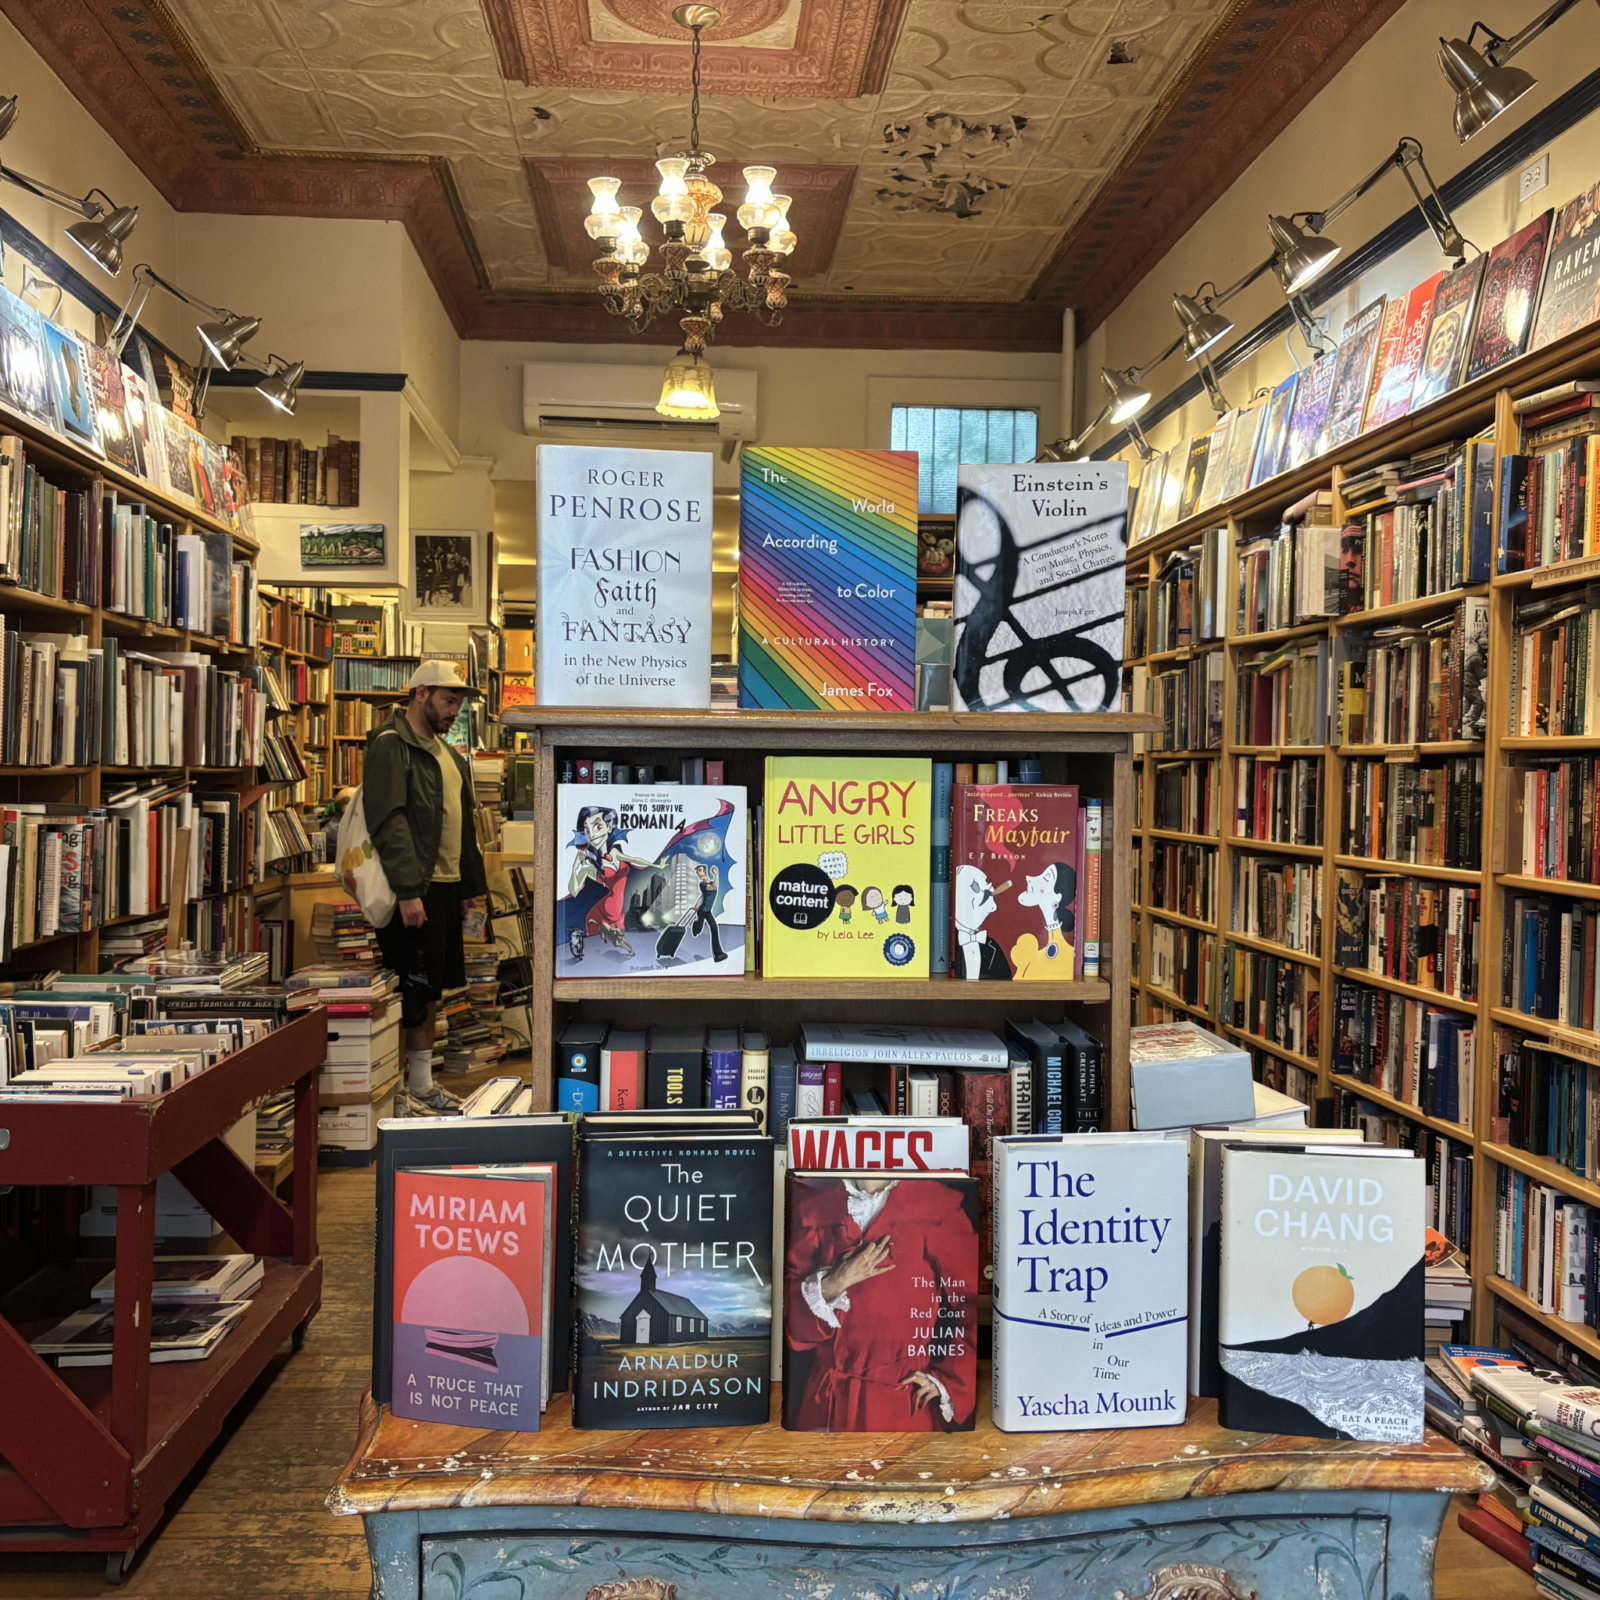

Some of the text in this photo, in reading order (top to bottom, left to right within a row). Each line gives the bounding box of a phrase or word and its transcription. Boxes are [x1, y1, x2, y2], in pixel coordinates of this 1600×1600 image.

[1554, 264, 1594, 294] TRAVELLING
[587, 468, 665, 488] ROGER
[761, 467, 788, 484] The
[1012, 472, 1108, 492] Einstein's
[549, 494, 702, 523] PENROSE
[851, 498, 895, 514] World
[1032, 498, 1087, 517] Violin
[762, 532, 838, 555] According
[1022, 531, 1109, 566] A Conductor's Notes
[571, 547, 681, 573] FASHION
[1036, 543, 1112, 574] on Music, Physics,
[1038, 553, 1116, 586] and Social Change
[594, 576, 657, 610] Faith
[837, 583, 896, 599] to Color
[616, 606, 634, 616] and
[1054, 608, 1078, 617] Joseph
[560, 612, 692, 644] FANTASY
[761, 637, 895, 647] A CULTURAL HISTORY
[564, 653, 688, 671] in the New Physics
[575, 672, 676, 687] of the Universe
[819, 682, 893, 697] James Fox
[620, 803, 683, 813] HOW TO SURVIVE
[778, 780, 916, 818] ANGRY
[620, 813, 686, 833] ROMANIA
[973, 804, 1039, 822] FREAKS
[778, 823, 916, 846] LITTLE GIRLS
[985, 825, 1071, 848] Mayfair
[991, 852, 1026, 860] BENSON
[778, 880, 829, 895] mature
[776, 893, 829, 909] content
[817, 930, 830, 941] by
[858, 930, 874, 940] Lee
[231, 1000, 246, 1008] THE
[249, 1000, 273, 1008] AGES
[811, 1047, 972, 1062] IRRELIGION JOHN ALLEN PAULOS
[666, 1067, 684, 1104] TOOLS
[800, 1071, 823, 1080] palgrave
[1047, 1056, 1062, 1104] MICHAEL
[1079, 1051, 1087, 1102] GREENBLATT
[896, 1080, 903, 1094] MY
[985, 1087, 994, 1104] Fall
[778, 1091, 787, 1118] In My
[986, 1105, 994, 1117] On
[1077, 1110, 1099, 1118] THE
[985, 1118, 994, 1134] Your
[660, 1163, 703, 1184] The
[1016, 1160, 1096, 1199] The
[1267, 1173, 1383, 1207] DAVID
[410, 1193, 527, 1226] MIRIAM
[624, 1193, 737, 1233] QUIET
[1017, 1206, 1173, 1254] Identity
[1254, 1208, 1394, 1243] CHANG
[415, 1224, 520, 1257] TOEWS
[596, 1241, 764, 1287] MOTHER
[911, 1276, 966, 1288] The Man
[1016, 1255, 1109, 1303] Trap
[931, 1292, 966, 1304] in the
[910, 1307, 966, 1319] Red Coat
[1038, 1307, 1093, 1325] A Story of
[1095, 1307, 1178, 1334] Ideas and Power
[912, 1326, 965, 1339] JULIAN
[908, 1344, 965, 1357] BARNES
[1092, 1338, 1104, 1351] in
[618, 1353, 739, 1372] ARNALDUR
[1107, 1354, 1130, 1368] Our
[1093, 1366, 1121, 1381] Time
[407, 1373, 524, 1398] A TRUCE THAT
[593, 1377, 762, 1400] INDRIDASON
[410, 1391, 519, 1417] IS NOT PEACE
[672, 1403, 691, 1411] JAR
[696, 1402, 719, 1410] CITY
[1017, 1388, 1177, 1417] Yascha Mounk
[1556, 1401, 1564, 1424] NAOMI
[1342, 1414, 1361, 1423] EAT
[1374, 1416, 1409, 1426] PEACH
[1562, 1403, 1571, 1428] KLEIN
[1572, 1408, 1582, 1431] SHOCK
